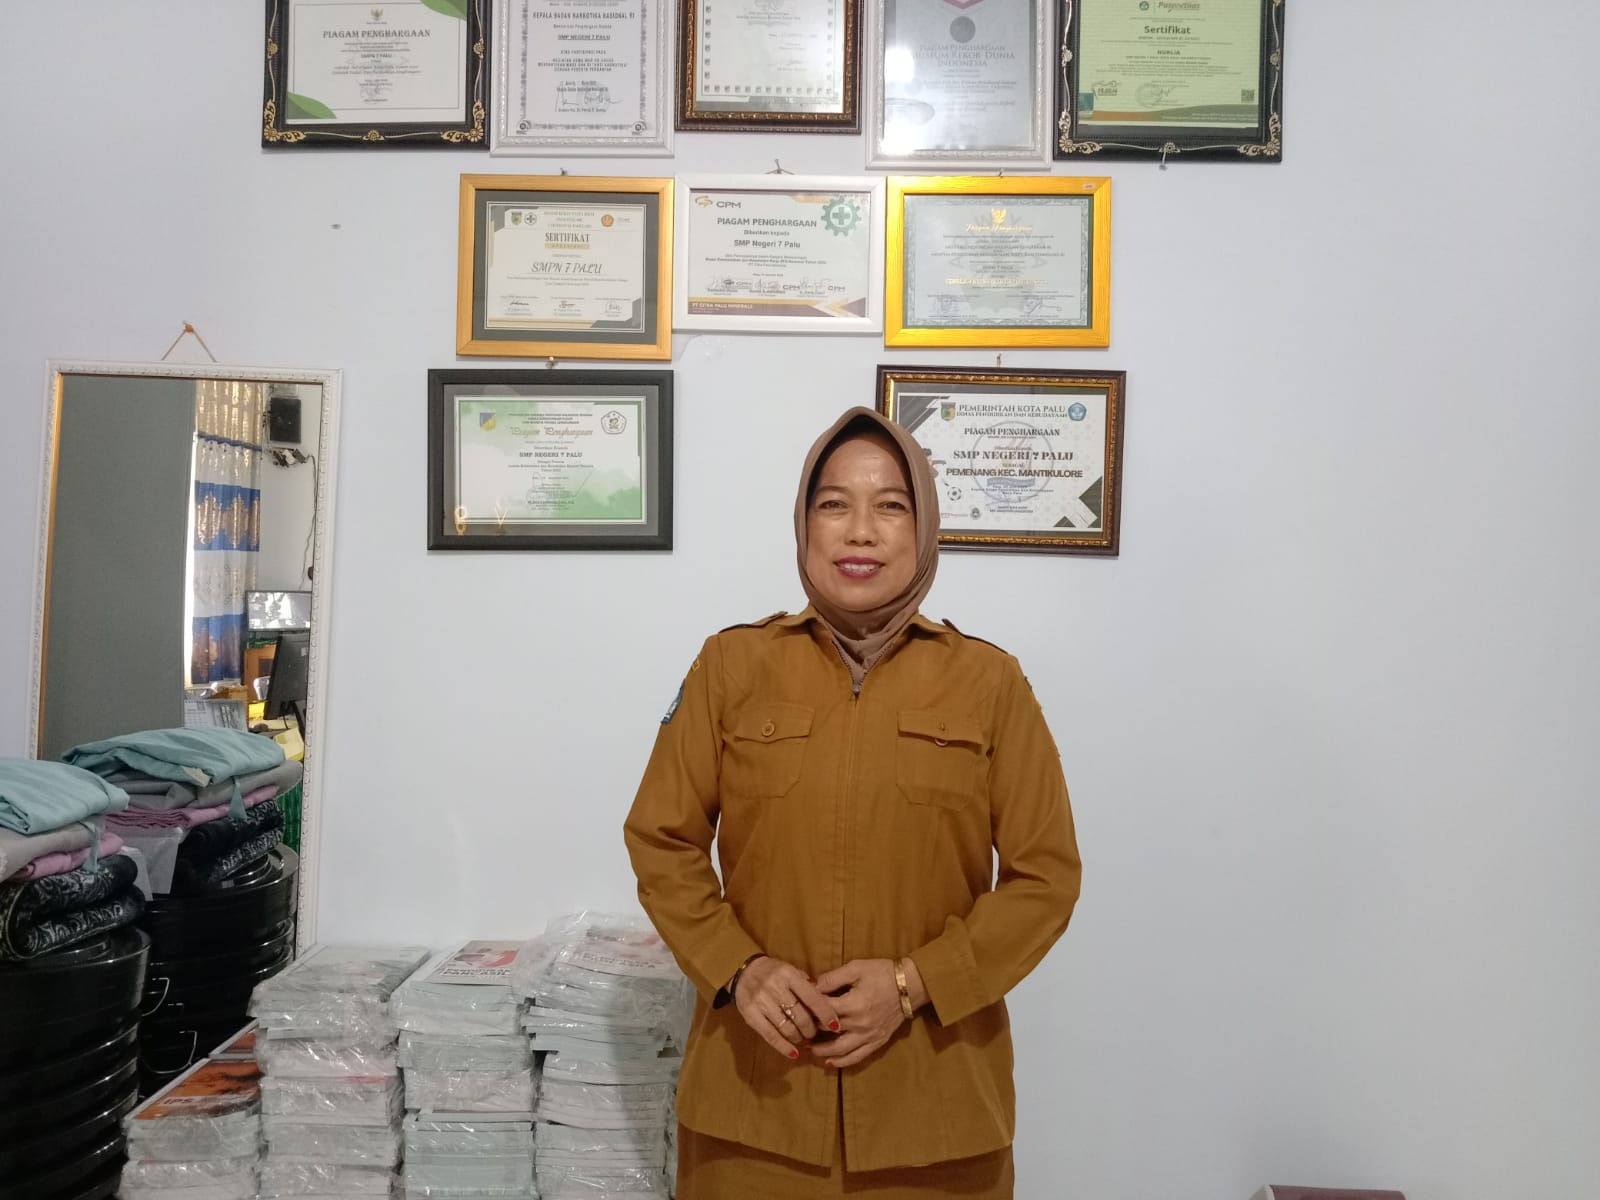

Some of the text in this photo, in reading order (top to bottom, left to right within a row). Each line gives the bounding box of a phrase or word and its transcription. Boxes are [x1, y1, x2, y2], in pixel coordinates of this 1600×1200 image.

[323, 30, 430, 38] PIAGAM PENGHARGAAN
[1144, 25, 1191, 34] Sertifikat
[752, 218, 817, 227] PENGHARGAAN
[545, 232, 589, 242] SERTIFIKAT
[752, 240, 776, 248] Negeri
[532, 262, 602, 274] SMPN 7 PALU
[998, 428, 1060, 436] PENGHARGAAN
[953, 450, 1074, 460] SMP NEGERI 7 PALU
[946, 468, 997, 476] PEMENANG
[1019, 469, 1083, 478] MANTIKULORE
